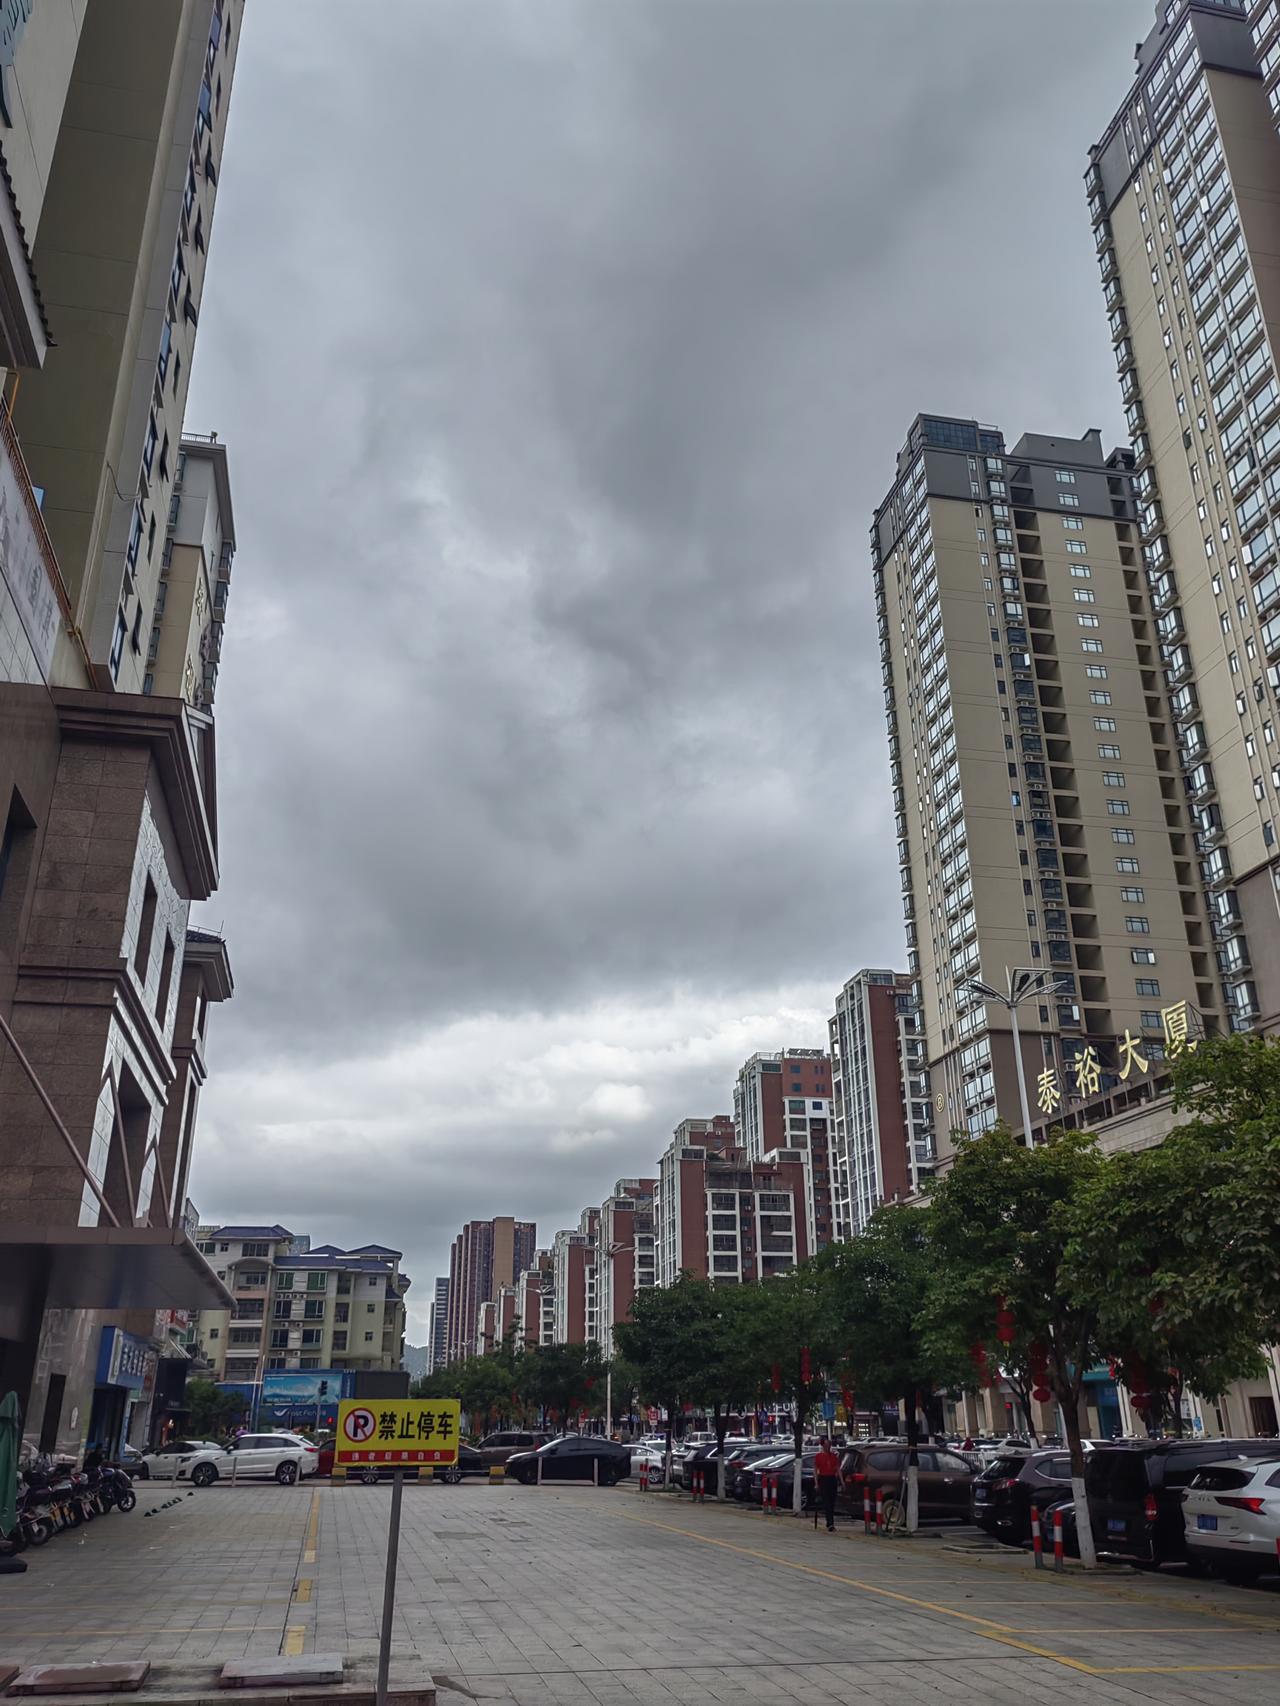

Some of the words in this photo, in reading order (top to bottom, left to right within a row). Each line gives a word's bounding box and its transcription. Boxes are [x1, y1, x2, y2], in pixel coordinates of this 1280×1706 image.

[1037, 1000, 1197, 1113] 泰裕大厦
[378, 1411, 454, 1441] 禁止停车
